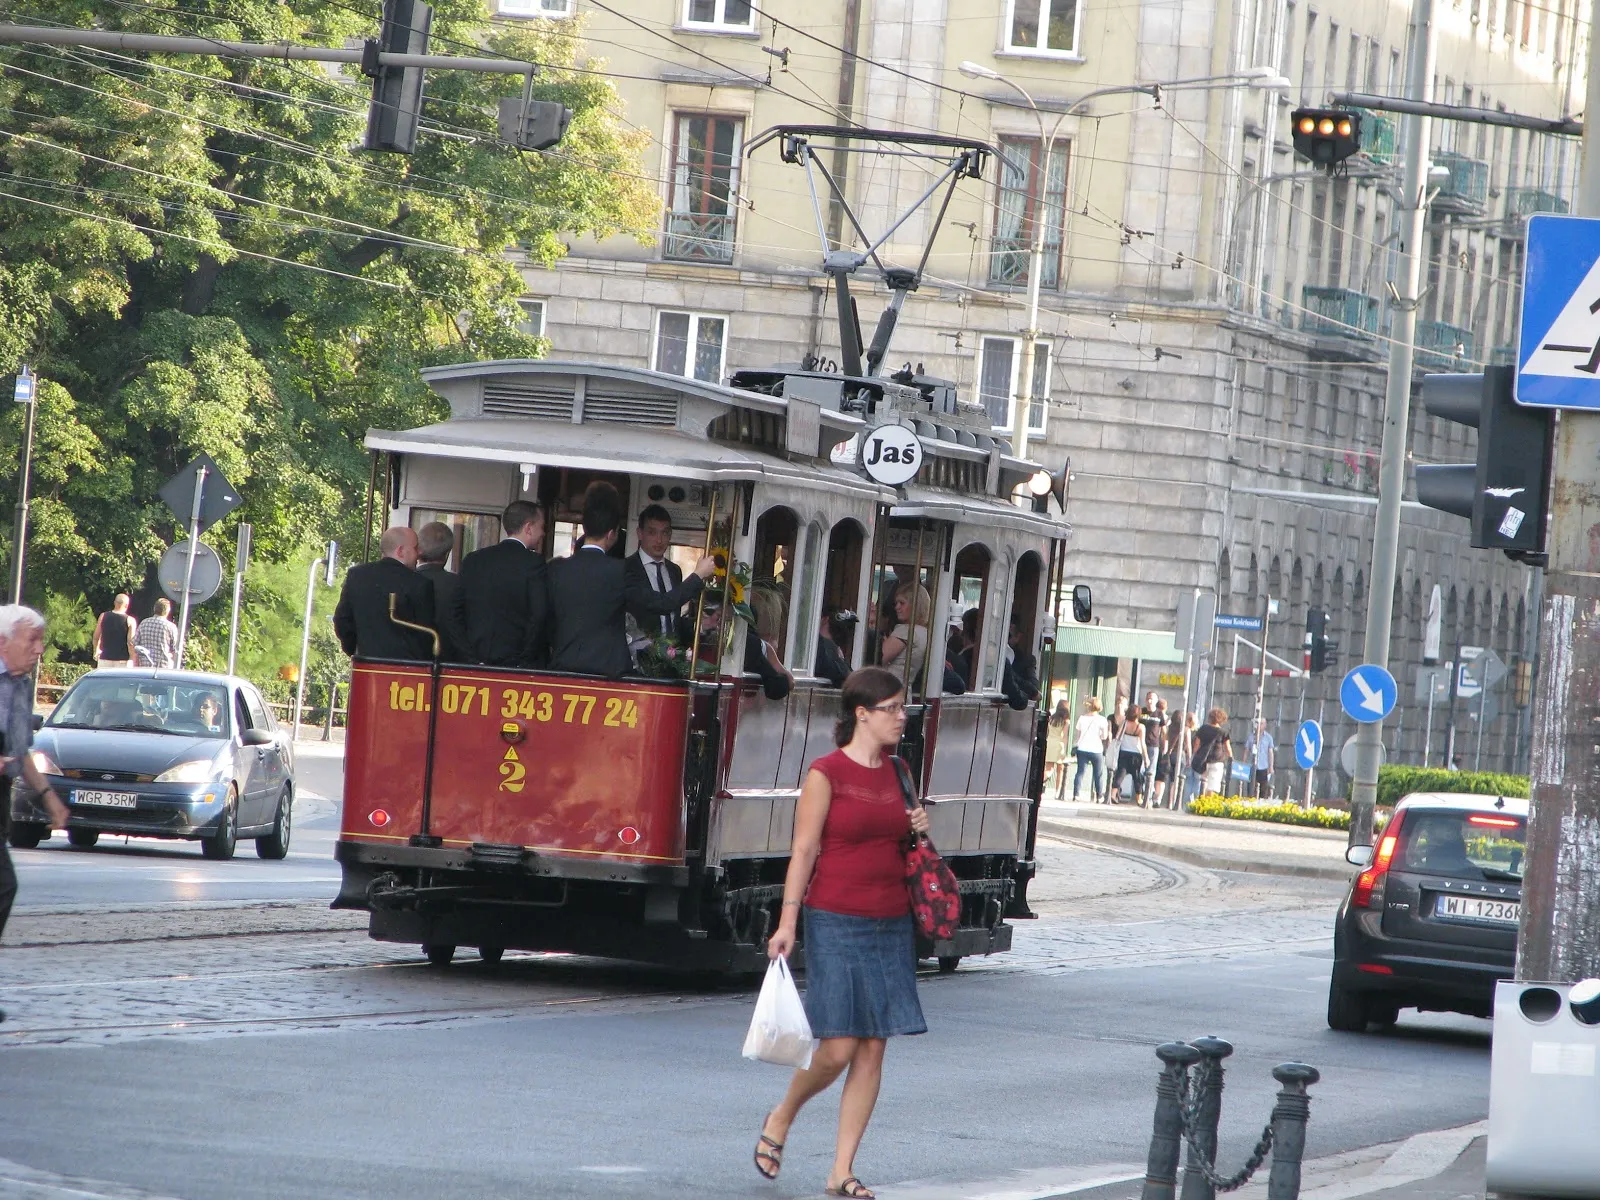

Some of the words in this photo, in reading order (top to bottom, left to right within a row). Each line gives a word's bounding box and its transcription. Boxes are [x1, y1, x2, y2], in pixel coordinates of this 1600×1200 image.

[867, 438, 915, 465] Jaś
[390, 681, 431, 712] tel.
[442, 684, 490, 716] 071
[501, 689, 553, 722] 343
[562, 694, 597, 724] 77
[604, 698, 638, 728] 24
[499, 761, 526, 792] 2
[78, 791, 103, 804] WGR
[107, 793, 136, 806] 35RM
